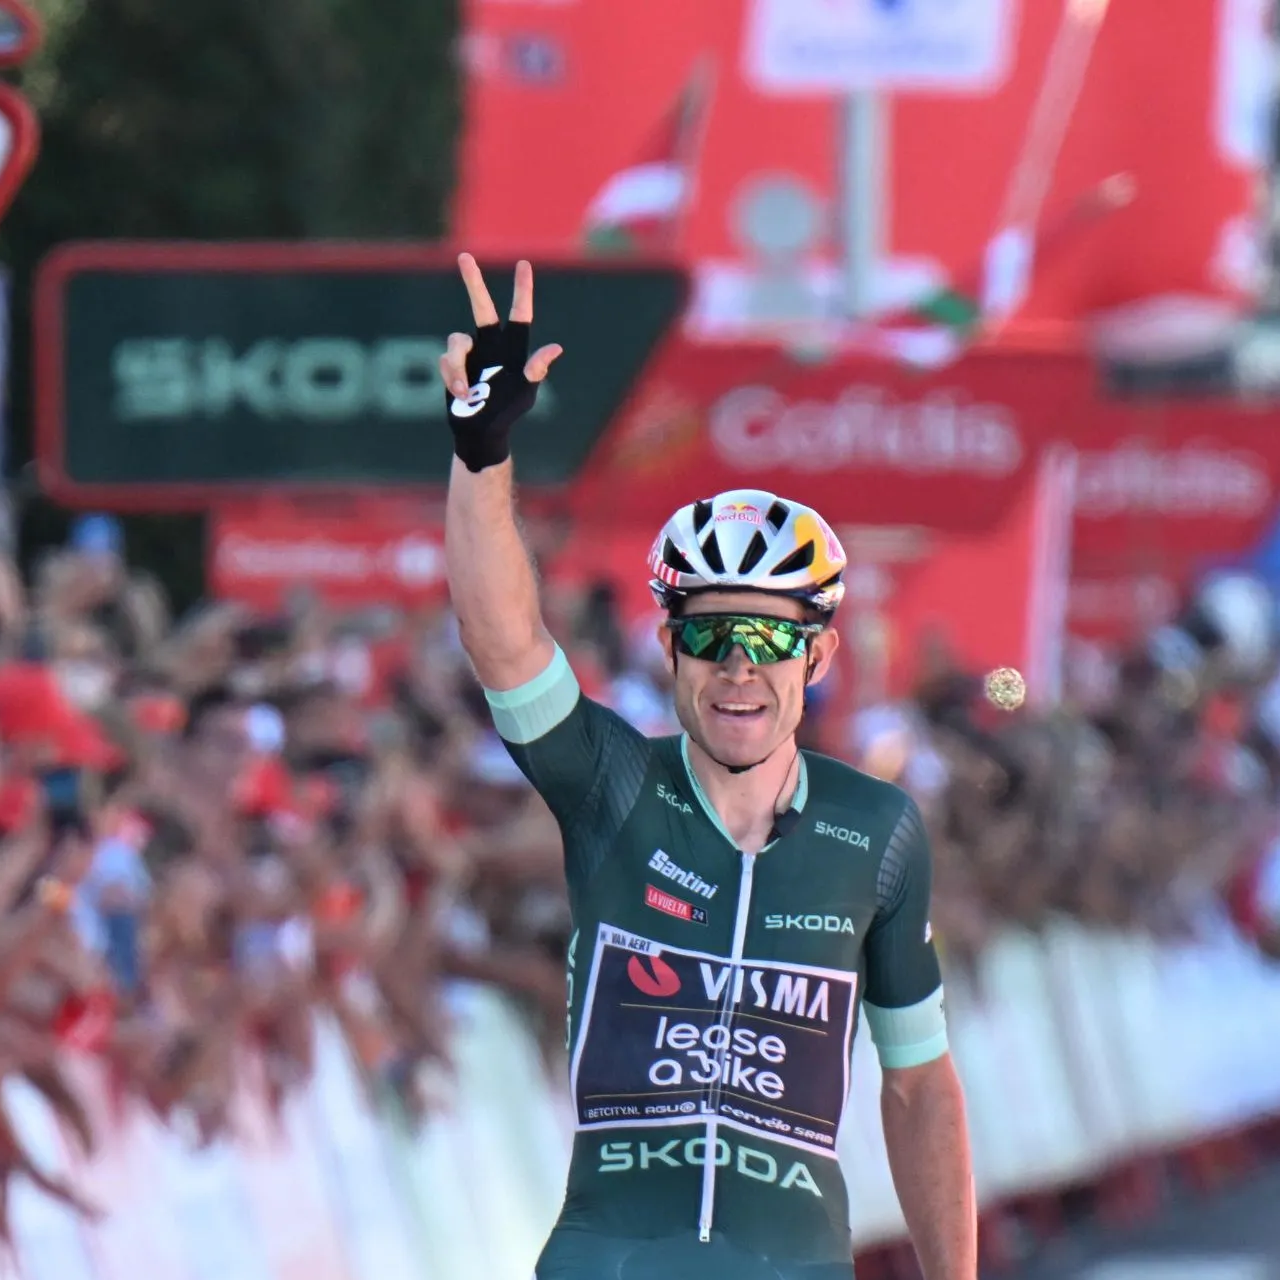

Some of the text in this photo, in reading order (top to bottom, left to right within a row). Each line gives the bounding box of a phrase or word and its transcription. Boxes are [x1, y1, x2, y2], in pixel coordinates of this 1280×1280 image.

[113, 338, 556, 420] SKOD
[738, 512, 761, 525] Bull
[814, 821, 870, 851] SKODA
[648, 849, 719, 899] Santini
[692, 909, 704, 921] 24
[765, 915, 855, 935] SKODA
[628, 938, 652, 951] AERT
[700, 962, 829, 1022] VISMA
[655, 1016, 786, 1063] lease
[587, 1104, 640, 1118] BETCITY.NL
[793, 1126, 834, 1145] SRAM
[598, 1137, 823, 1198] SKODA
